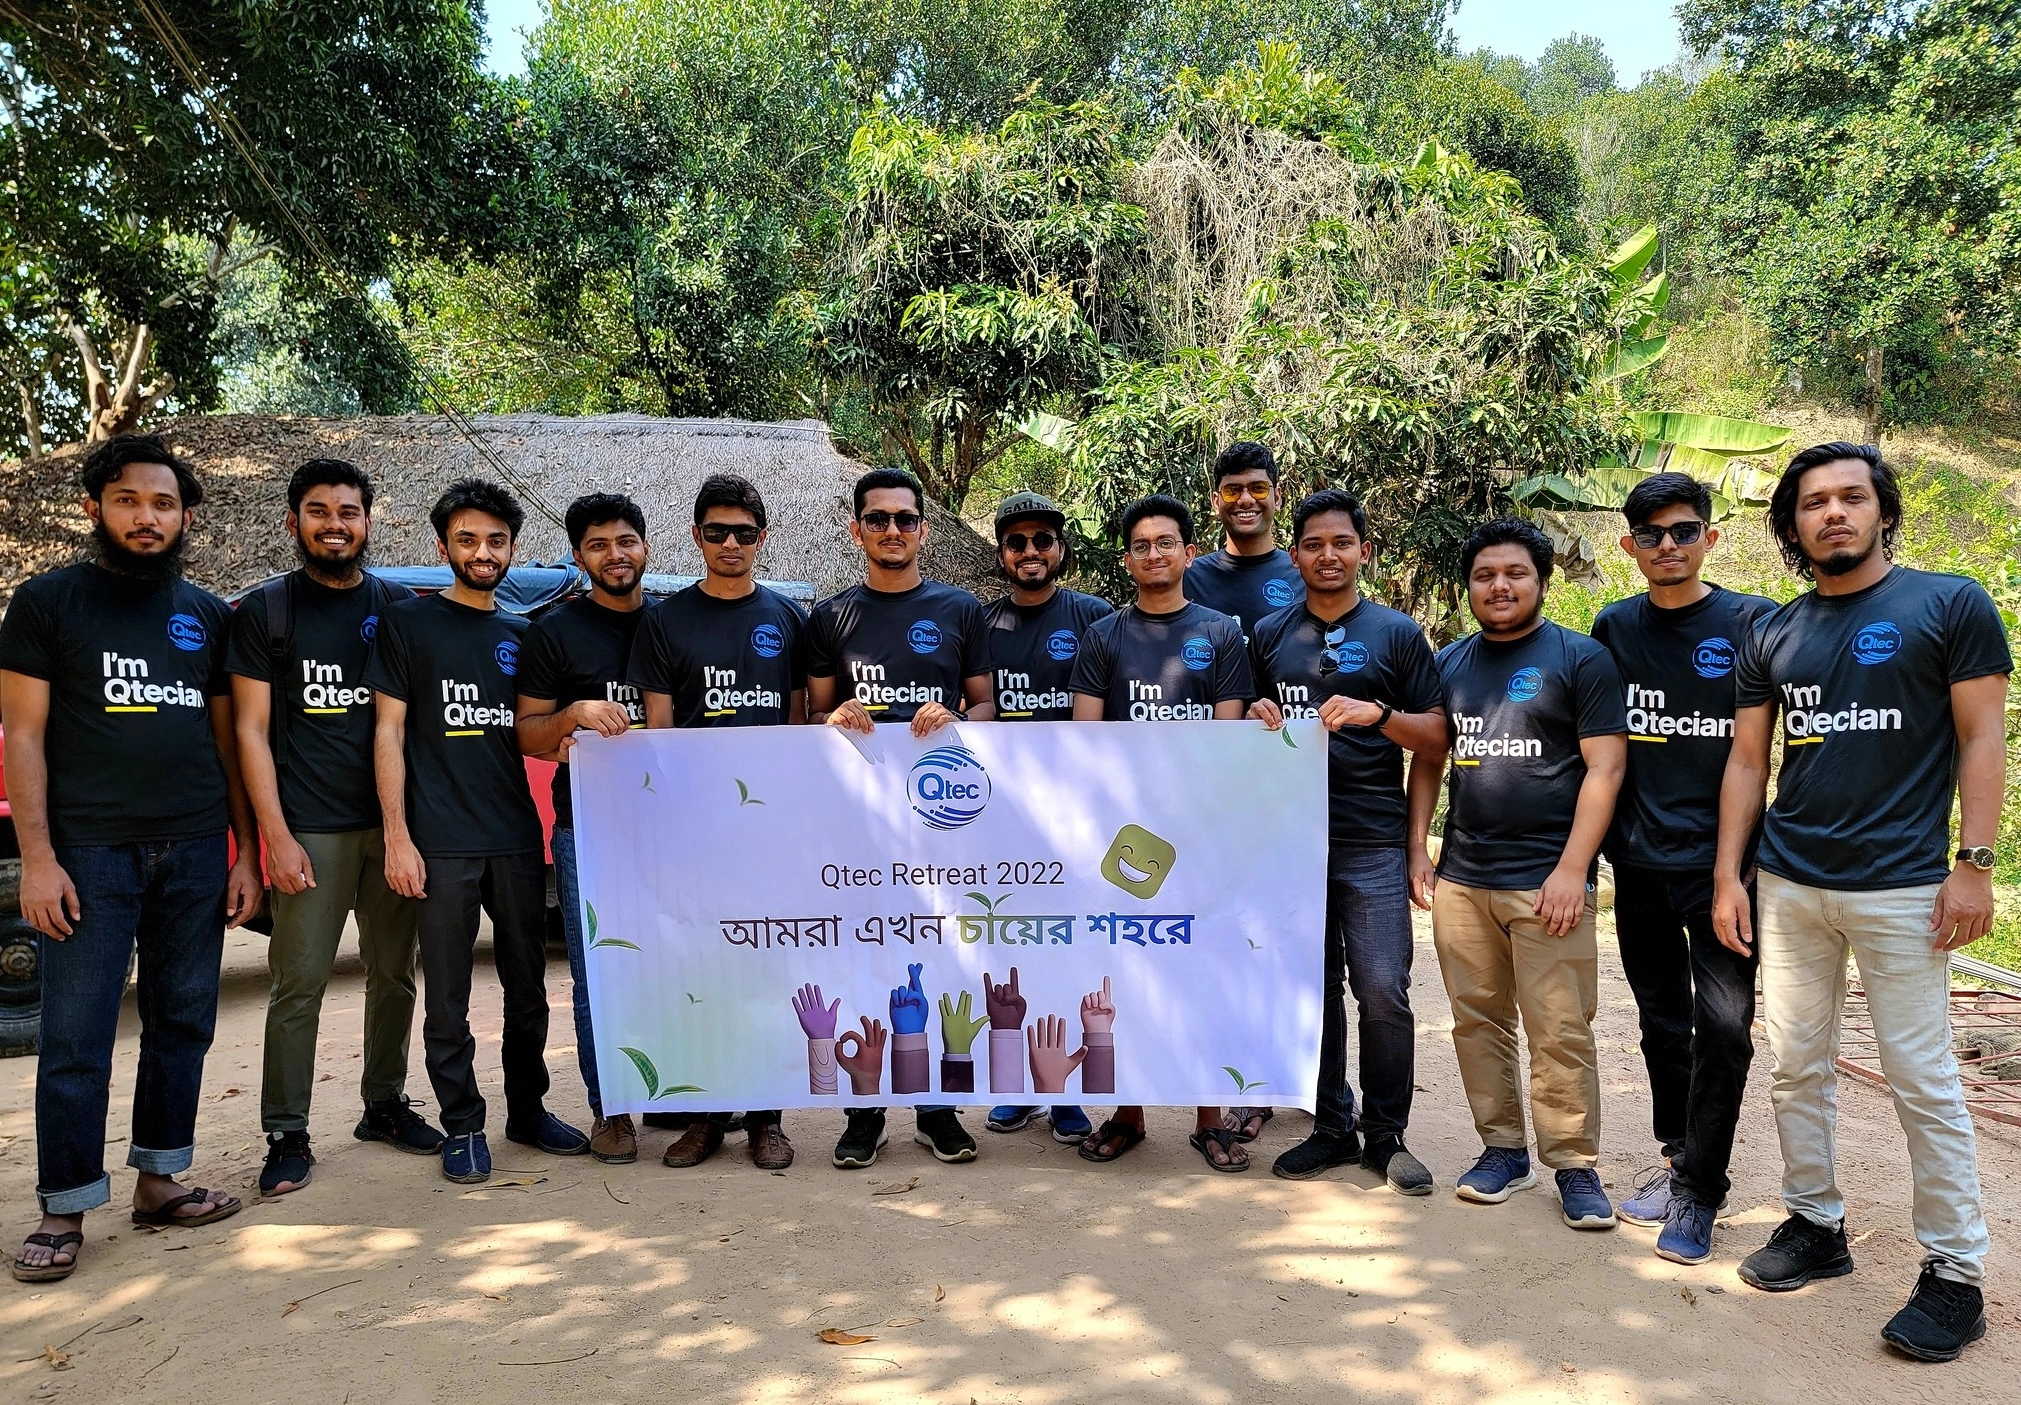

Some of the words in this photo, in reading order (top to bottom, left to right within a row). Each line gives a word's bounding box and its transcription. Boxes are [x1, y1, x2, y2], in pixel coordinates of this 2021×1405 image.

[1267, 586, 1291, 599] Qtec
[171, 622, 202, 640] Qtec
[755, 633, 780, 647] Qtec
[912, 629, 938, 643] Qtec
[1858, 634, 1894, 650] Qtec
[1051, 638, 1075, 650] Qtec
[1185, 647, 1211, 659] Qtec
[103, 652, 148, 677] I'm
[500, 649, 517, 664] Qte
[1698, 649, 1730, 665] Qtec
[303, 659, 343, 683] I'm
[704, 666, 736, 688] I'm
[851, 661, 885, 681] I'm
[998, 669, 1030, 689] I'm
[104, 678, 204, 708] Qtecian
[442, 679, 478, 702] I'm
[606, 681, 639, 702] I'm
[855, 681, 943, 705] Qtecian
[1129, 680, 1162, 701] I'm
[1276, 682, 1308, 703] I'm
[1511, 677, 1537, 690] Qtec
[705, 684, 781, 710] Qtecian
[1626, 683, 1665, 709] I'm
[444, 703, 514, 727] Qtecia
[1130, 698, 1214, 721] Qtecian
[1786, 702, 1902, 737] Qtecian
[1452, 712, 1484, 734] I'm
[1626, 710, 1735, 737] Qtecian
[1456, 732, 1542, 758] Qtecian
[918, 772, 980, 801] Qtec
[821, 863, 883, 890] Qtec
[892, 862, 988, 886] Retreat
[996, 861, 1065, 886] 2022
[719, 914, 843, 948] আমরা
[855, 912, 946, 946] এখন
[956, 912, 1076, 946] চায়ের
[1086, 911, 1195, 947] শহরে
